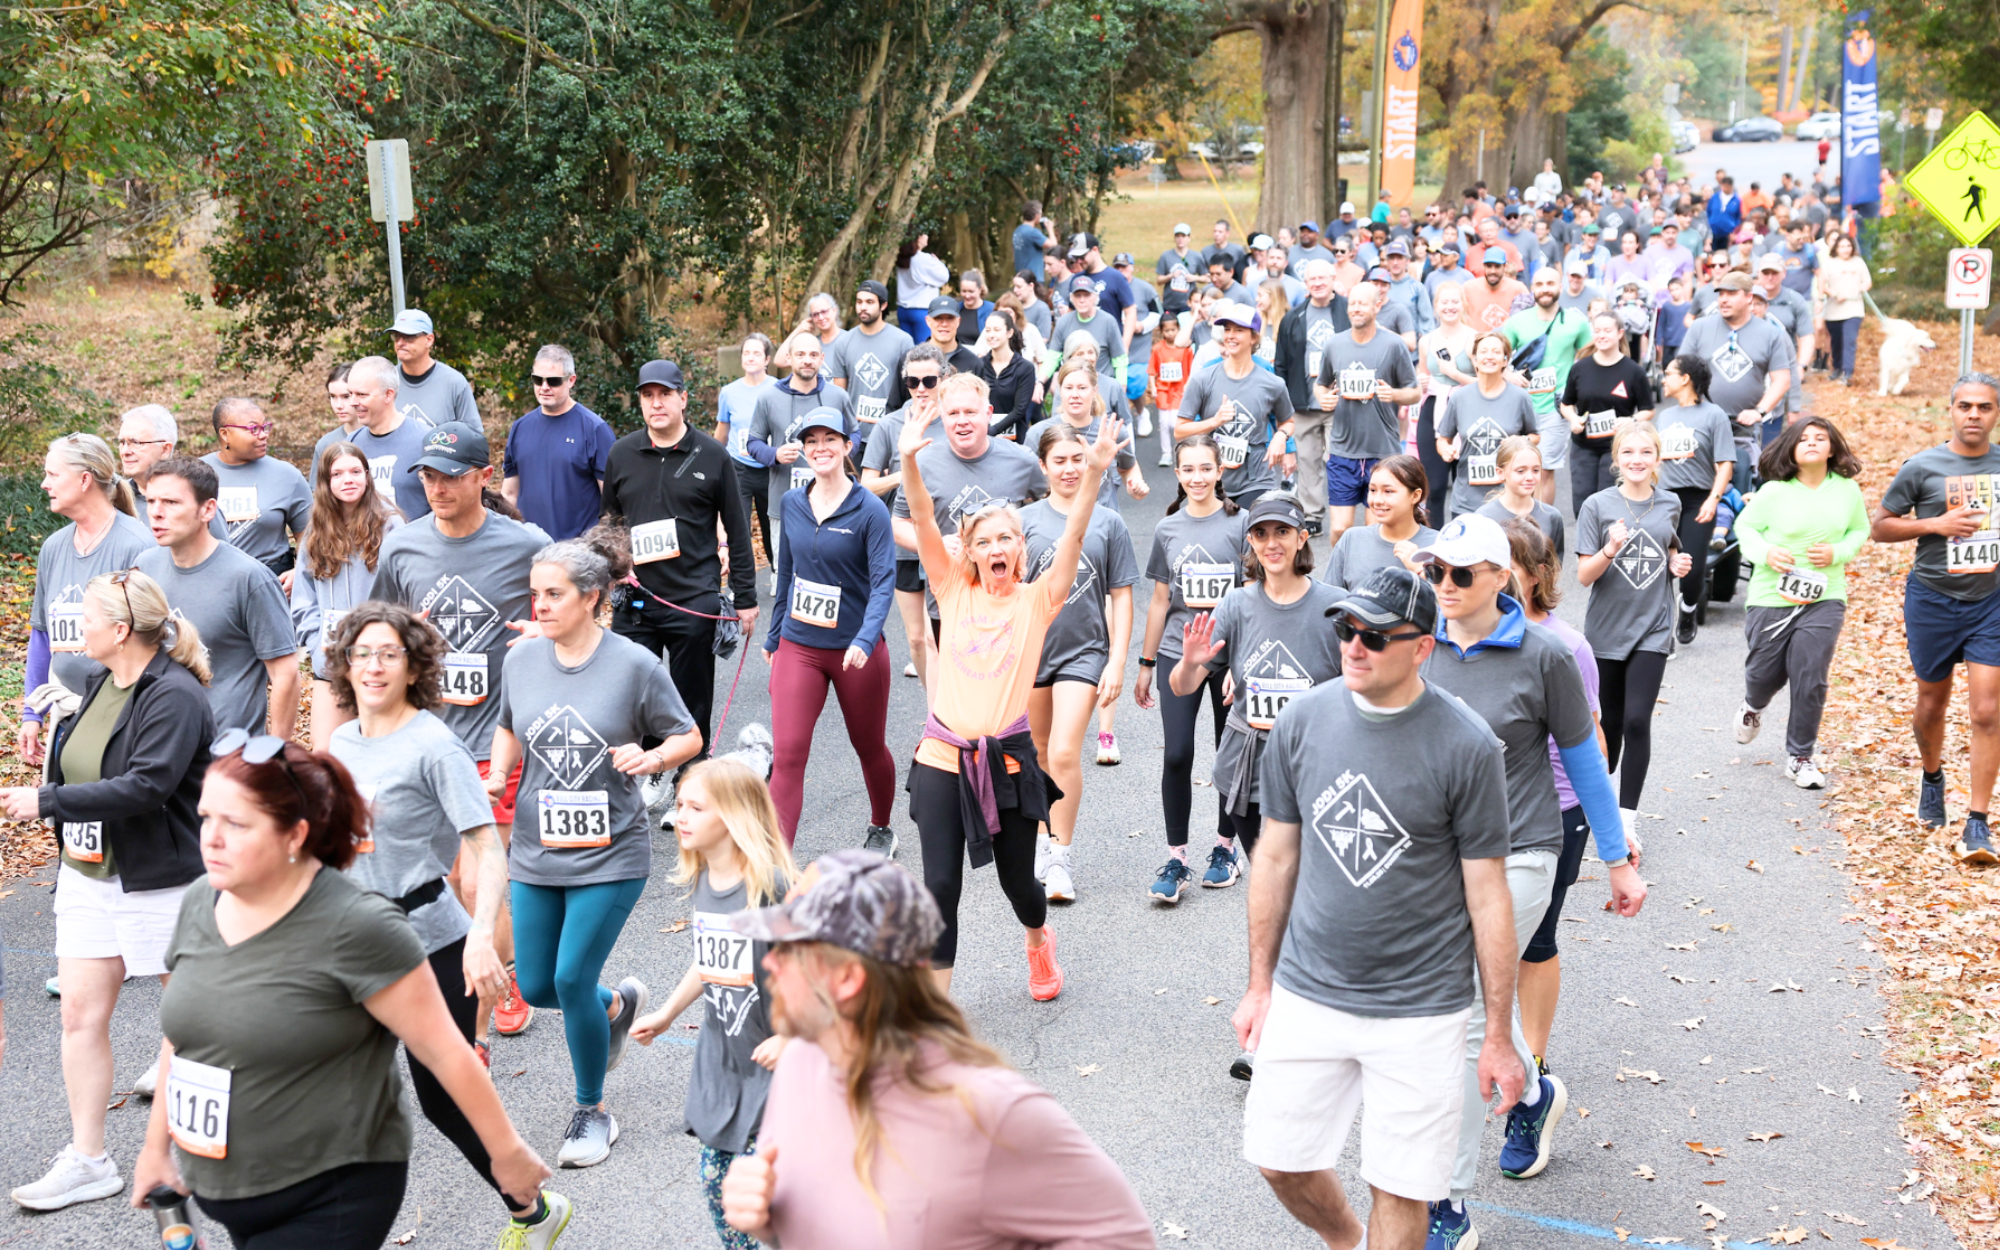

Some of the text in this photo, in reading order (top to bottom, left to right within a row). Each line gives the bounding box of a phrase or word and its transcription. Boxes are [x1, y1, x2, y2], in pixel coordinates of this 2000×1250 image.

[1385, 84, 1418, 159] START
[1844, 79, 1880, 158] START
[1161, 369, 1181, 379] 1218
[1342, 379, 1373, 393] 1407
[859, 404, 885, 418] 1022
[1220, 445, 1244, 463] 406
[372, 466, 392, 479] UN
[1471, 464, 1496, 479] 100
[222, 497, 254, 514] 361
[634, 532, 676, 556] 1094
[1952, 543, 1999, 565] 1440
[1185, 578, 1232, 599] 1167
[1779, 575, 1823, 600] 1439
[795, 592, 836, 620] 1478
[51, 619, 84, 642] 101
[1242, 638, 1273, 672] JODI 5K
[443, 670, 484, 696] 148
[524, 703, 561, 741] JODI 5K
[1312, 769, 1355, 816] JODI 5K
[543, 809, 606, 836] 1383
[697, 935, 747, 970] 1387
